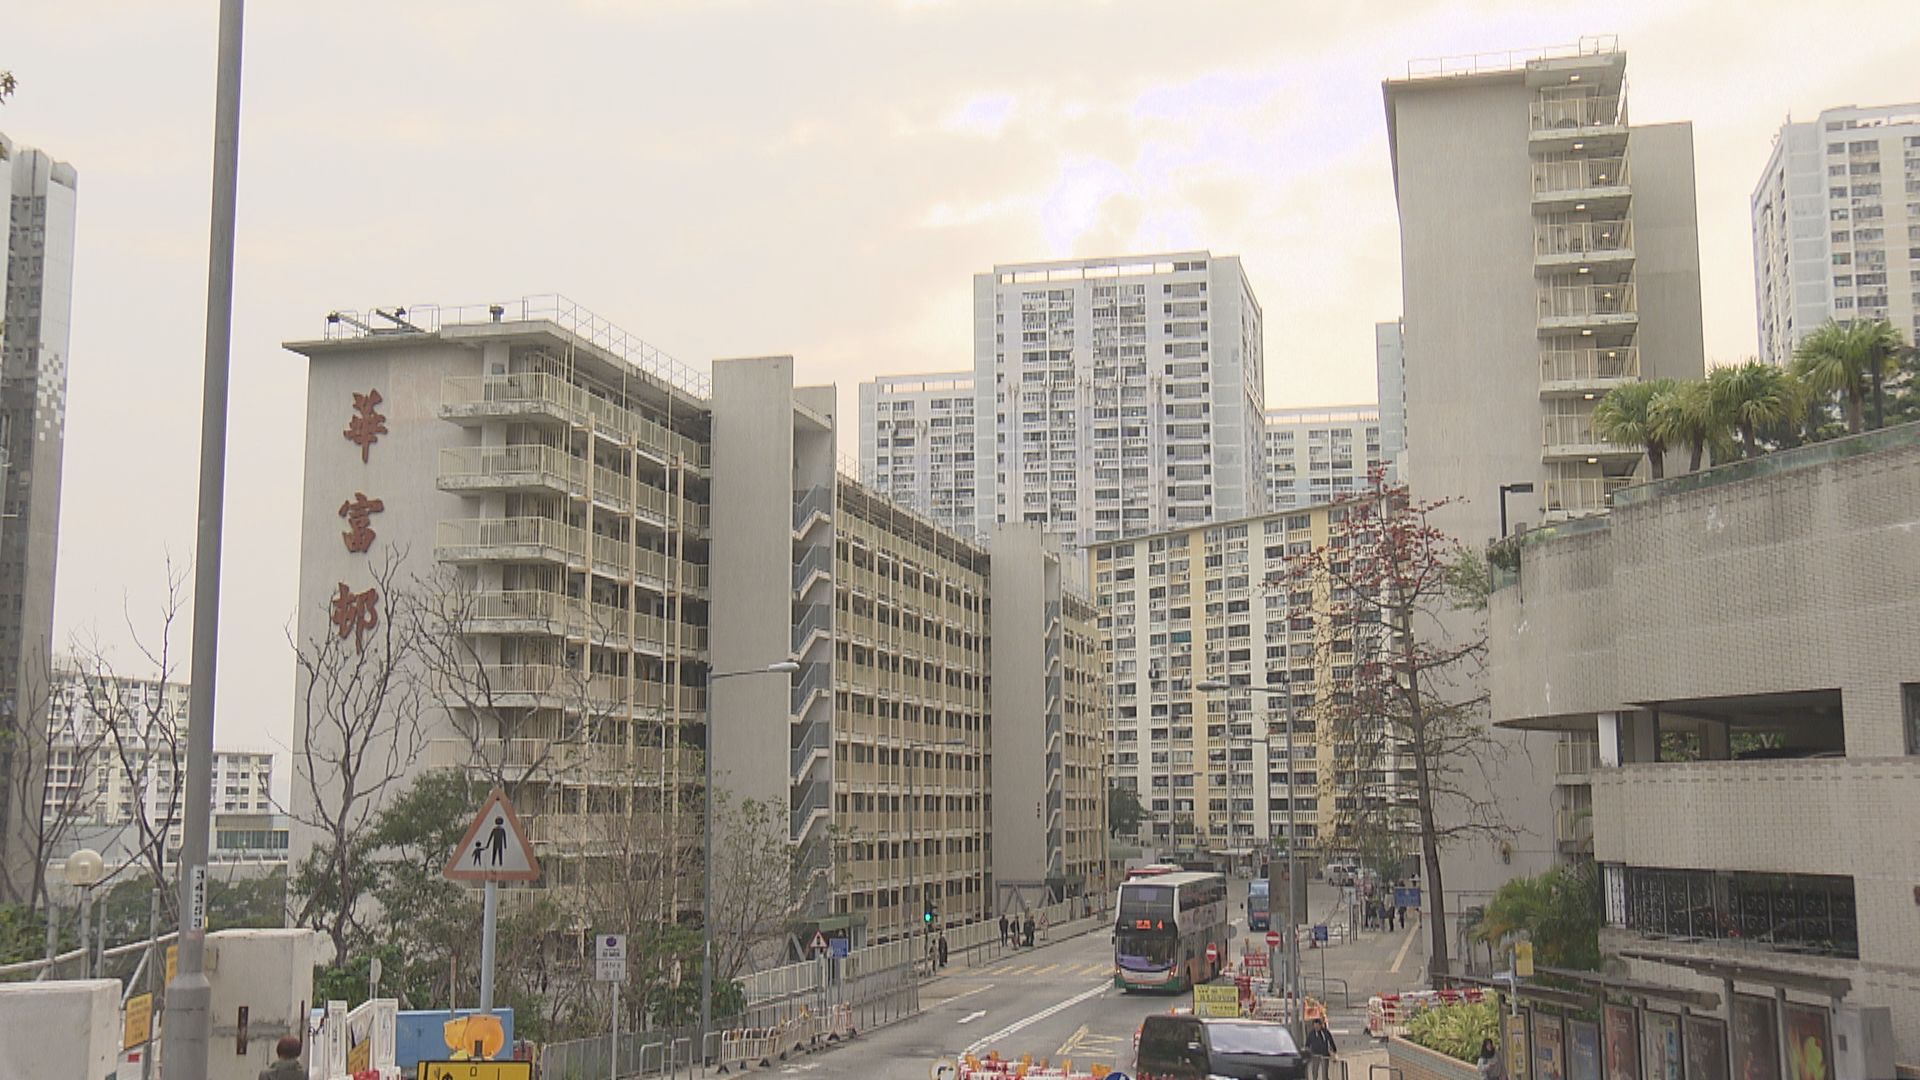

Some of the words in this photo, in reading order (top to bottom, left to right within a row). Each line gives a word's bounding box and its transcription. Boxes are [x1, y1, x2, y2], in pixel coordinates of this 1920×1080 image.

[332, 388, 388, 655] 華富邨
[1157, 919, 1163, 929] 4
